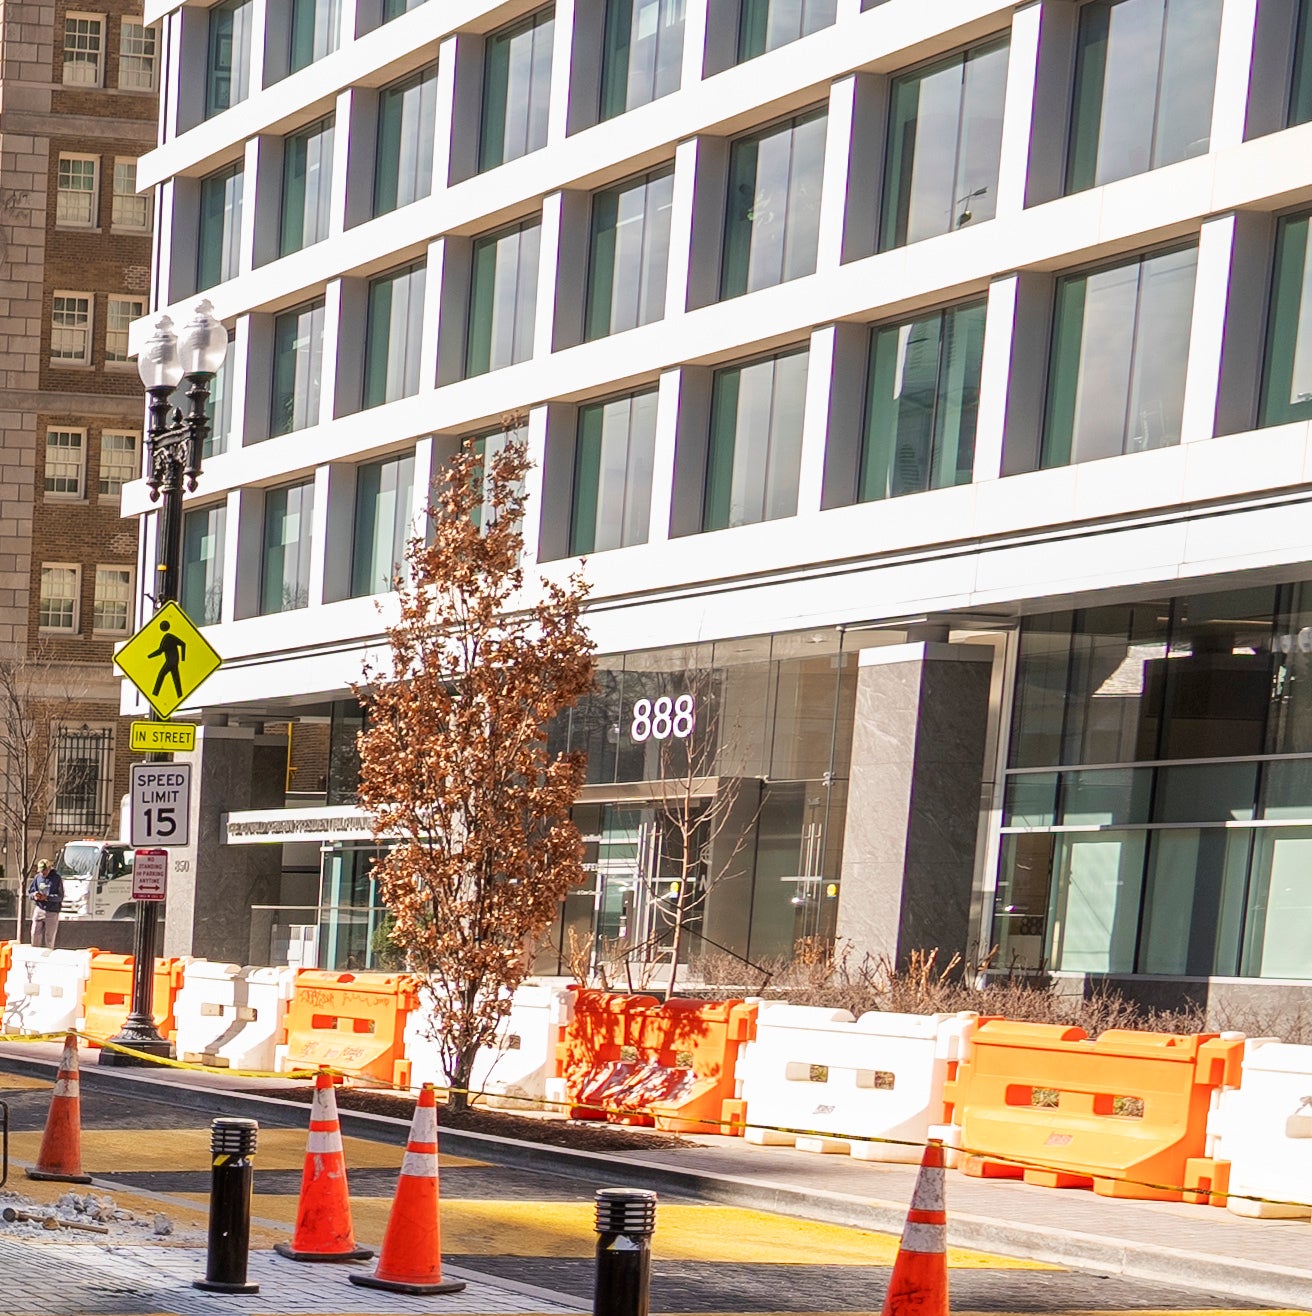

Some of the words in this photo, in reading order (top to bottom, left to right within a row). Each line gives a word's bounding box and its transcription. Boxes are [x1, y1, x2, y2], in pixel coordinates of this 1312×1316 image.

[631, 694, 693, 741] 888
[136, 731, 146, 742] IN
[152, 731, 191, 743] STREET
[137, 774, 185, 787] SPEED
[142, 790, 180, 803] LIMIT
[144, 808, 177, 837] 15
